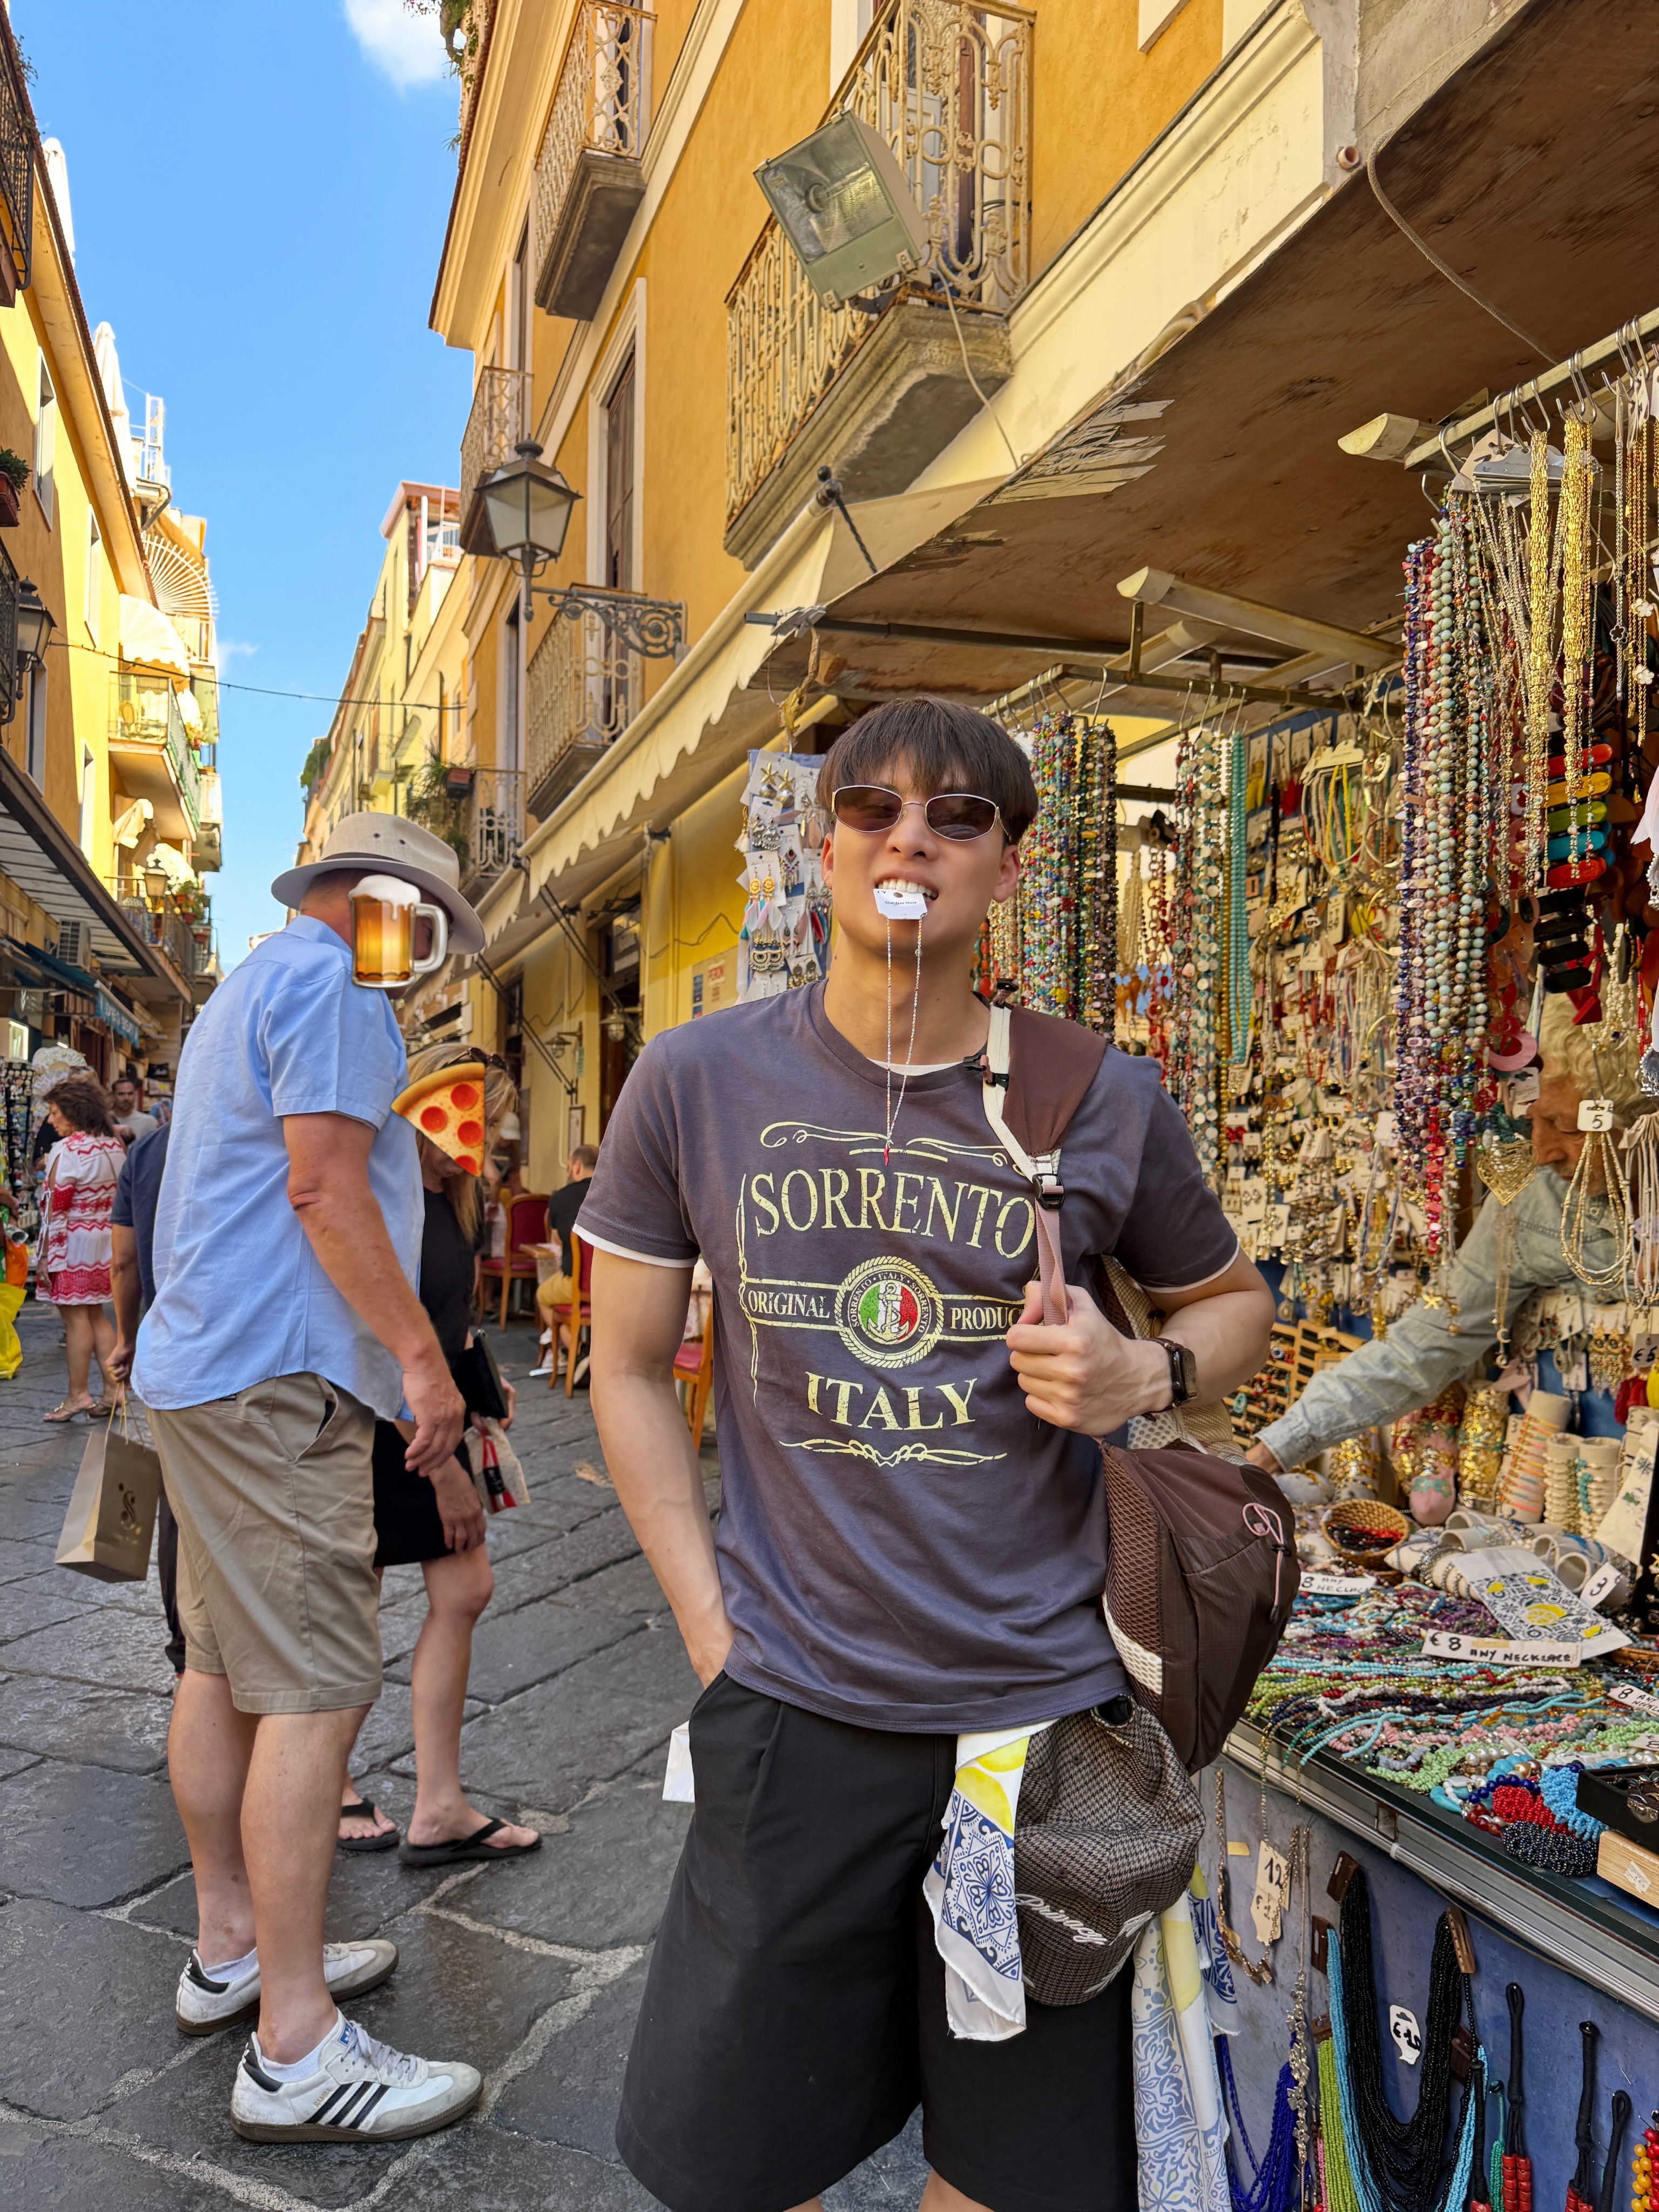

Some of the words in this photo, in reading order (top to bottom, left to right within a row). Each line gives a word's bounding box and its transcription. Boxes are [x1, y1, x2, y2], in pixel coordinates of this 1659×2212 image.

[1591, 1114, 1604, 1129] 5
[751, 1169, 1035, 1259] SORRENTO
[748, 1290, 830, 1318] ORIGINAL
[950, 1306, 1024, 1330] PRODUC
[849, 1278, 872, 1327] SORRENTO
[878, 1272, 906, 1282] ITALY
[910, 1282, 929, 1333] SORRENTO
[805, 1372, 978, 1430] ITALY
[1302, 1577, 1314, 1588] 8
[1590, 1577, 1608, 1596] 3
[1429, 1632, 1442, 1646] €
[1448, 1637, 1461, 1651] 8
[1470, 1649, 1497, 1661] ANY
[1503, 1653, 1571, 1662] NECKLACE
[1618, 1688, 1634, 1699] 8
[1264, 1857, 1284, 1890] 12
[1015, 1893, 1107, 1945] Privacy
[313, 2088, 332, 2107] SAMBA
